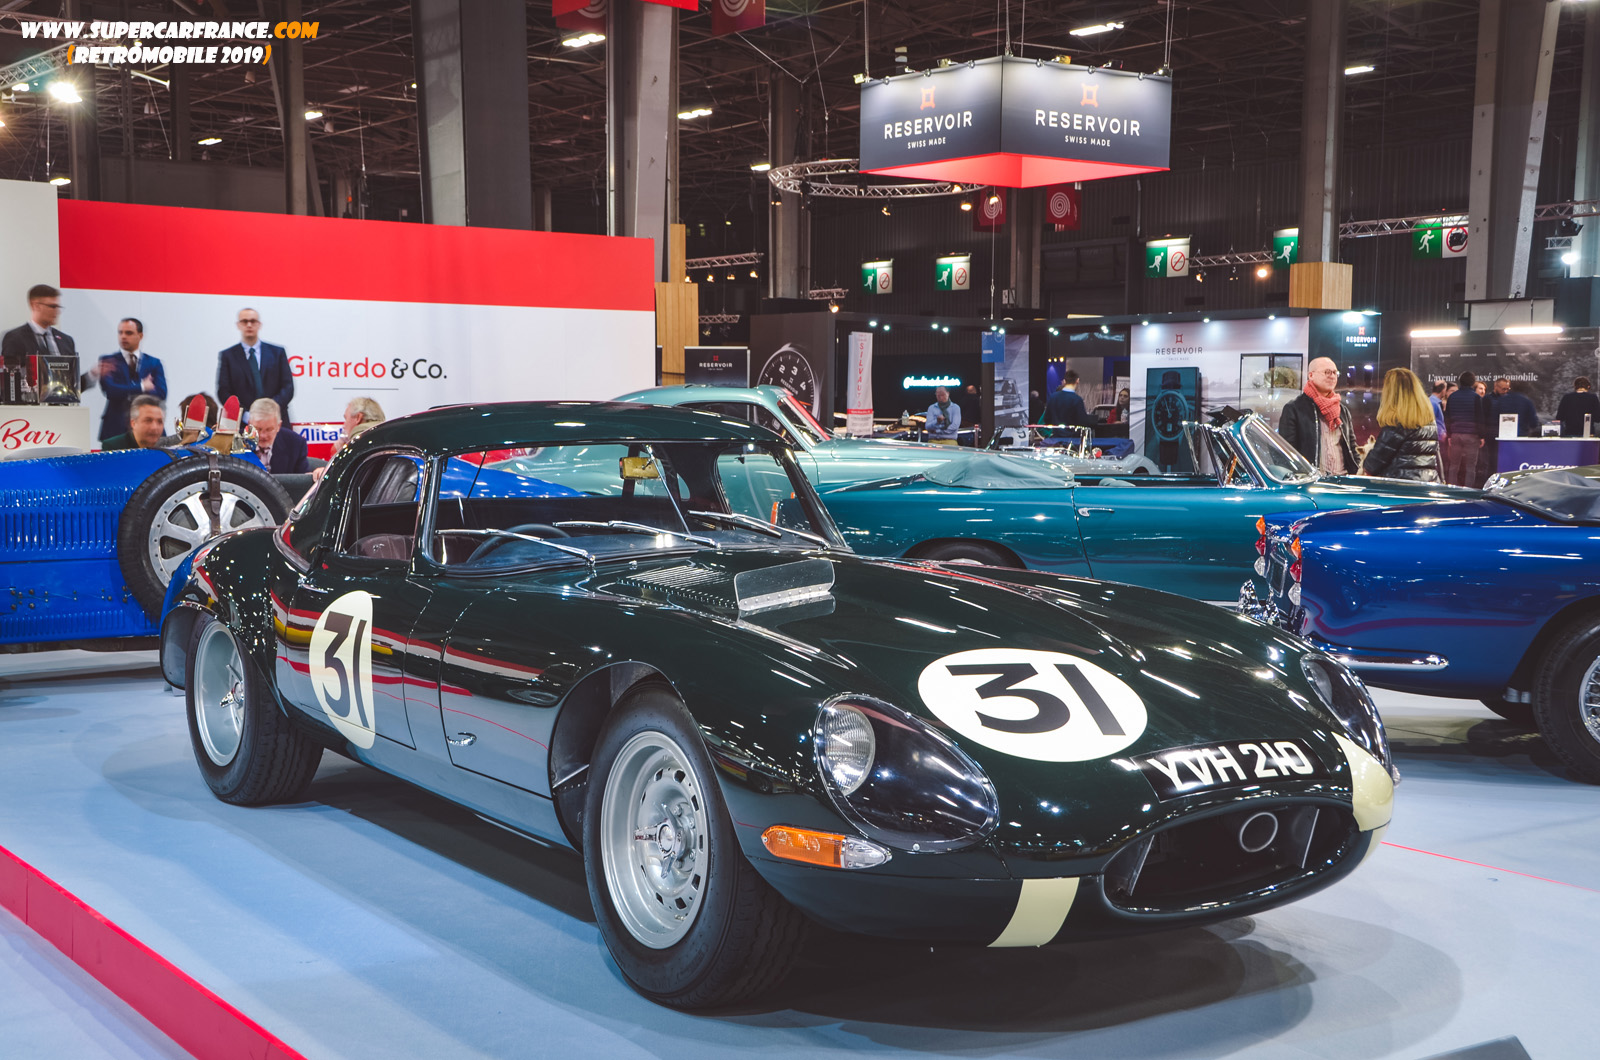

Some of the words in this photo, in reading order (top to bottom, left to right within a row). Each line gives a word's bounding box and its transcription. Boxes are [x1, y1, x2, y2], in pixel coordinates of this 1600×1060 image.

[884, 111, 973, 140] RESERVOIR
[1035, 109, 1141, 137] RESERVOIR
[907, 139, 927, 150] SWISS
[928, 136, 946, 146] MADE
[1064, 135, 1088, 145] SWISS
[1090, 138, 1111, 147] MADE
[1155, 346, 1203, 356] RESERVOIR
[287, 355, 386, 378] Girardo
[0, 418, 61, 450] Bar
[299, 427, 344, 441] Alita
[322, 611, 369, 729] 31
[945, 663, 1127, 736] 31
[1146, 746, 1247, 792] YVH
[1238, 741, 1314, 778] 210
